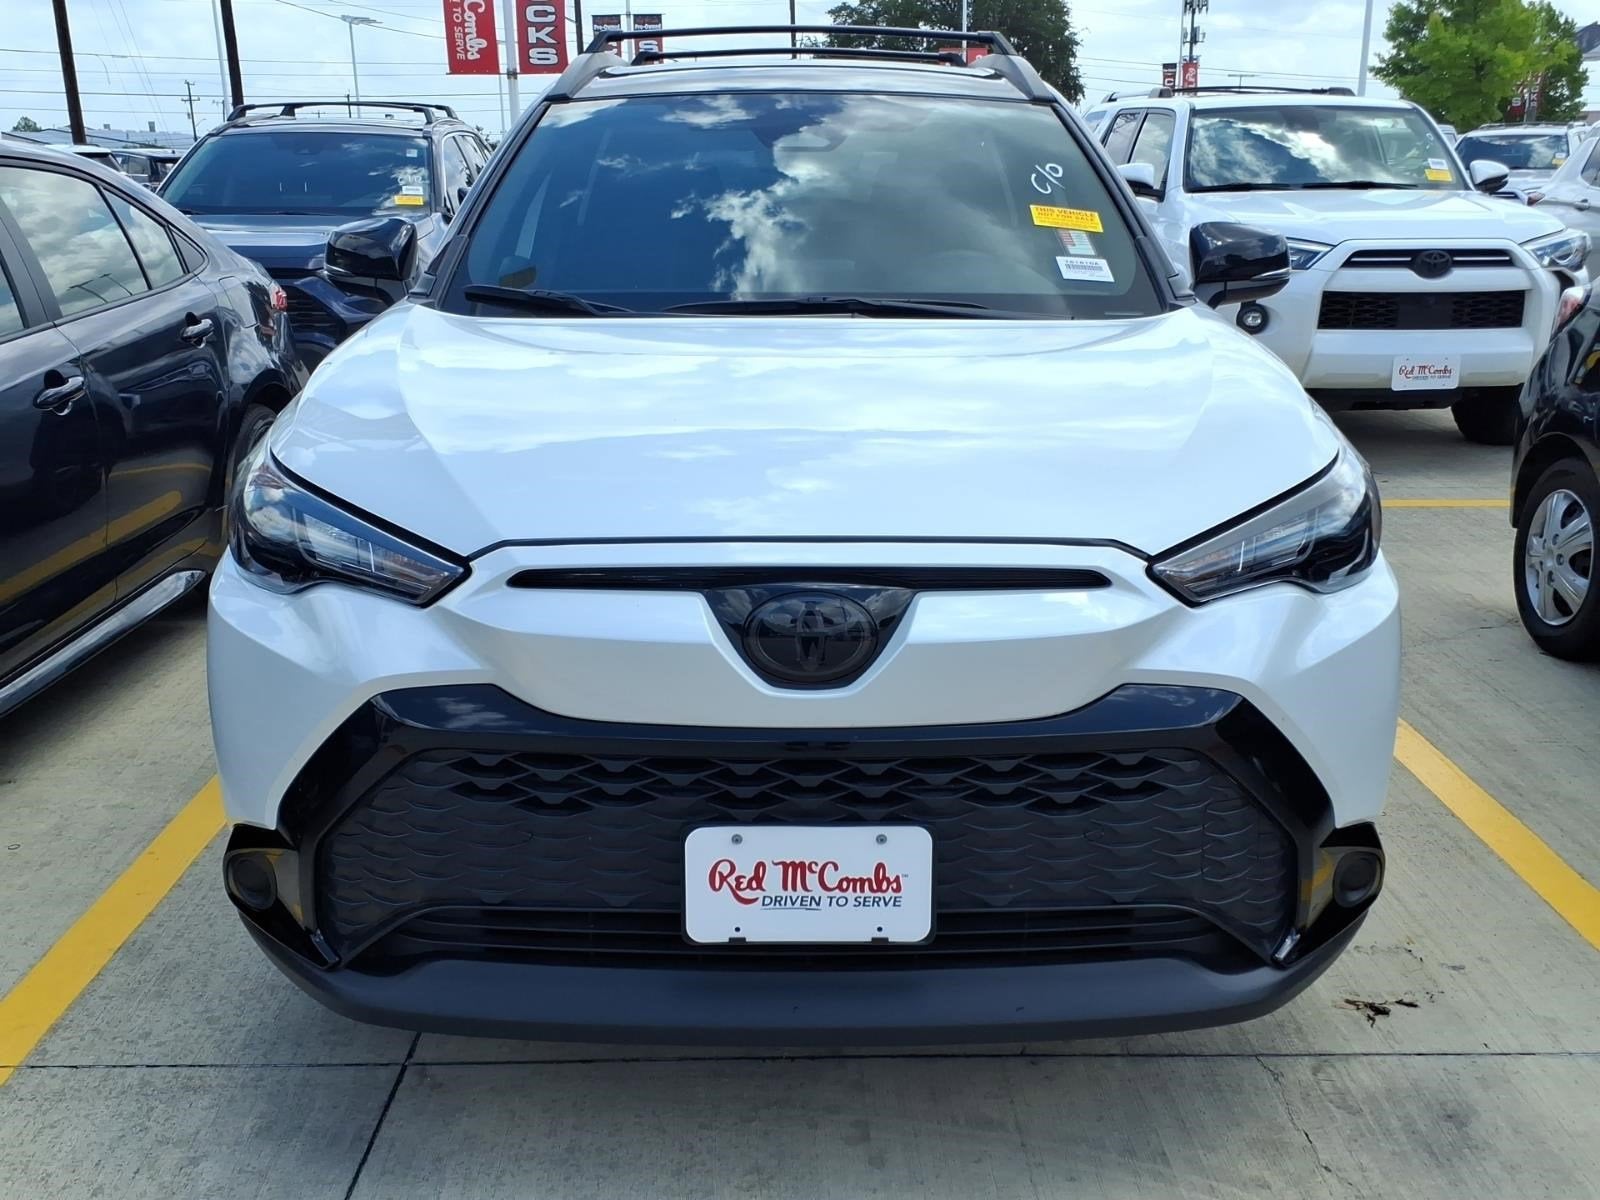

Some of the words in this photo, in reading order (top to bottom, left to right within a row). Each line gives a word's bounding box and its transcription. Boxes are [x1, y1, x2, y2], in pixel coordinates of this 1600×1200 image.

[452, 7, 462, 23] TO
[454, 26, 465, 60] SERVE
[525, 0, 558, 65] CKS
[708, 859, 767, 905] Red
[772, 861, 902, 893] McCombs
[761, 895, 822, 907] DRIVEN
[827, 895, 849, 907] TO
[853, 895, 902, 908] SERVE
